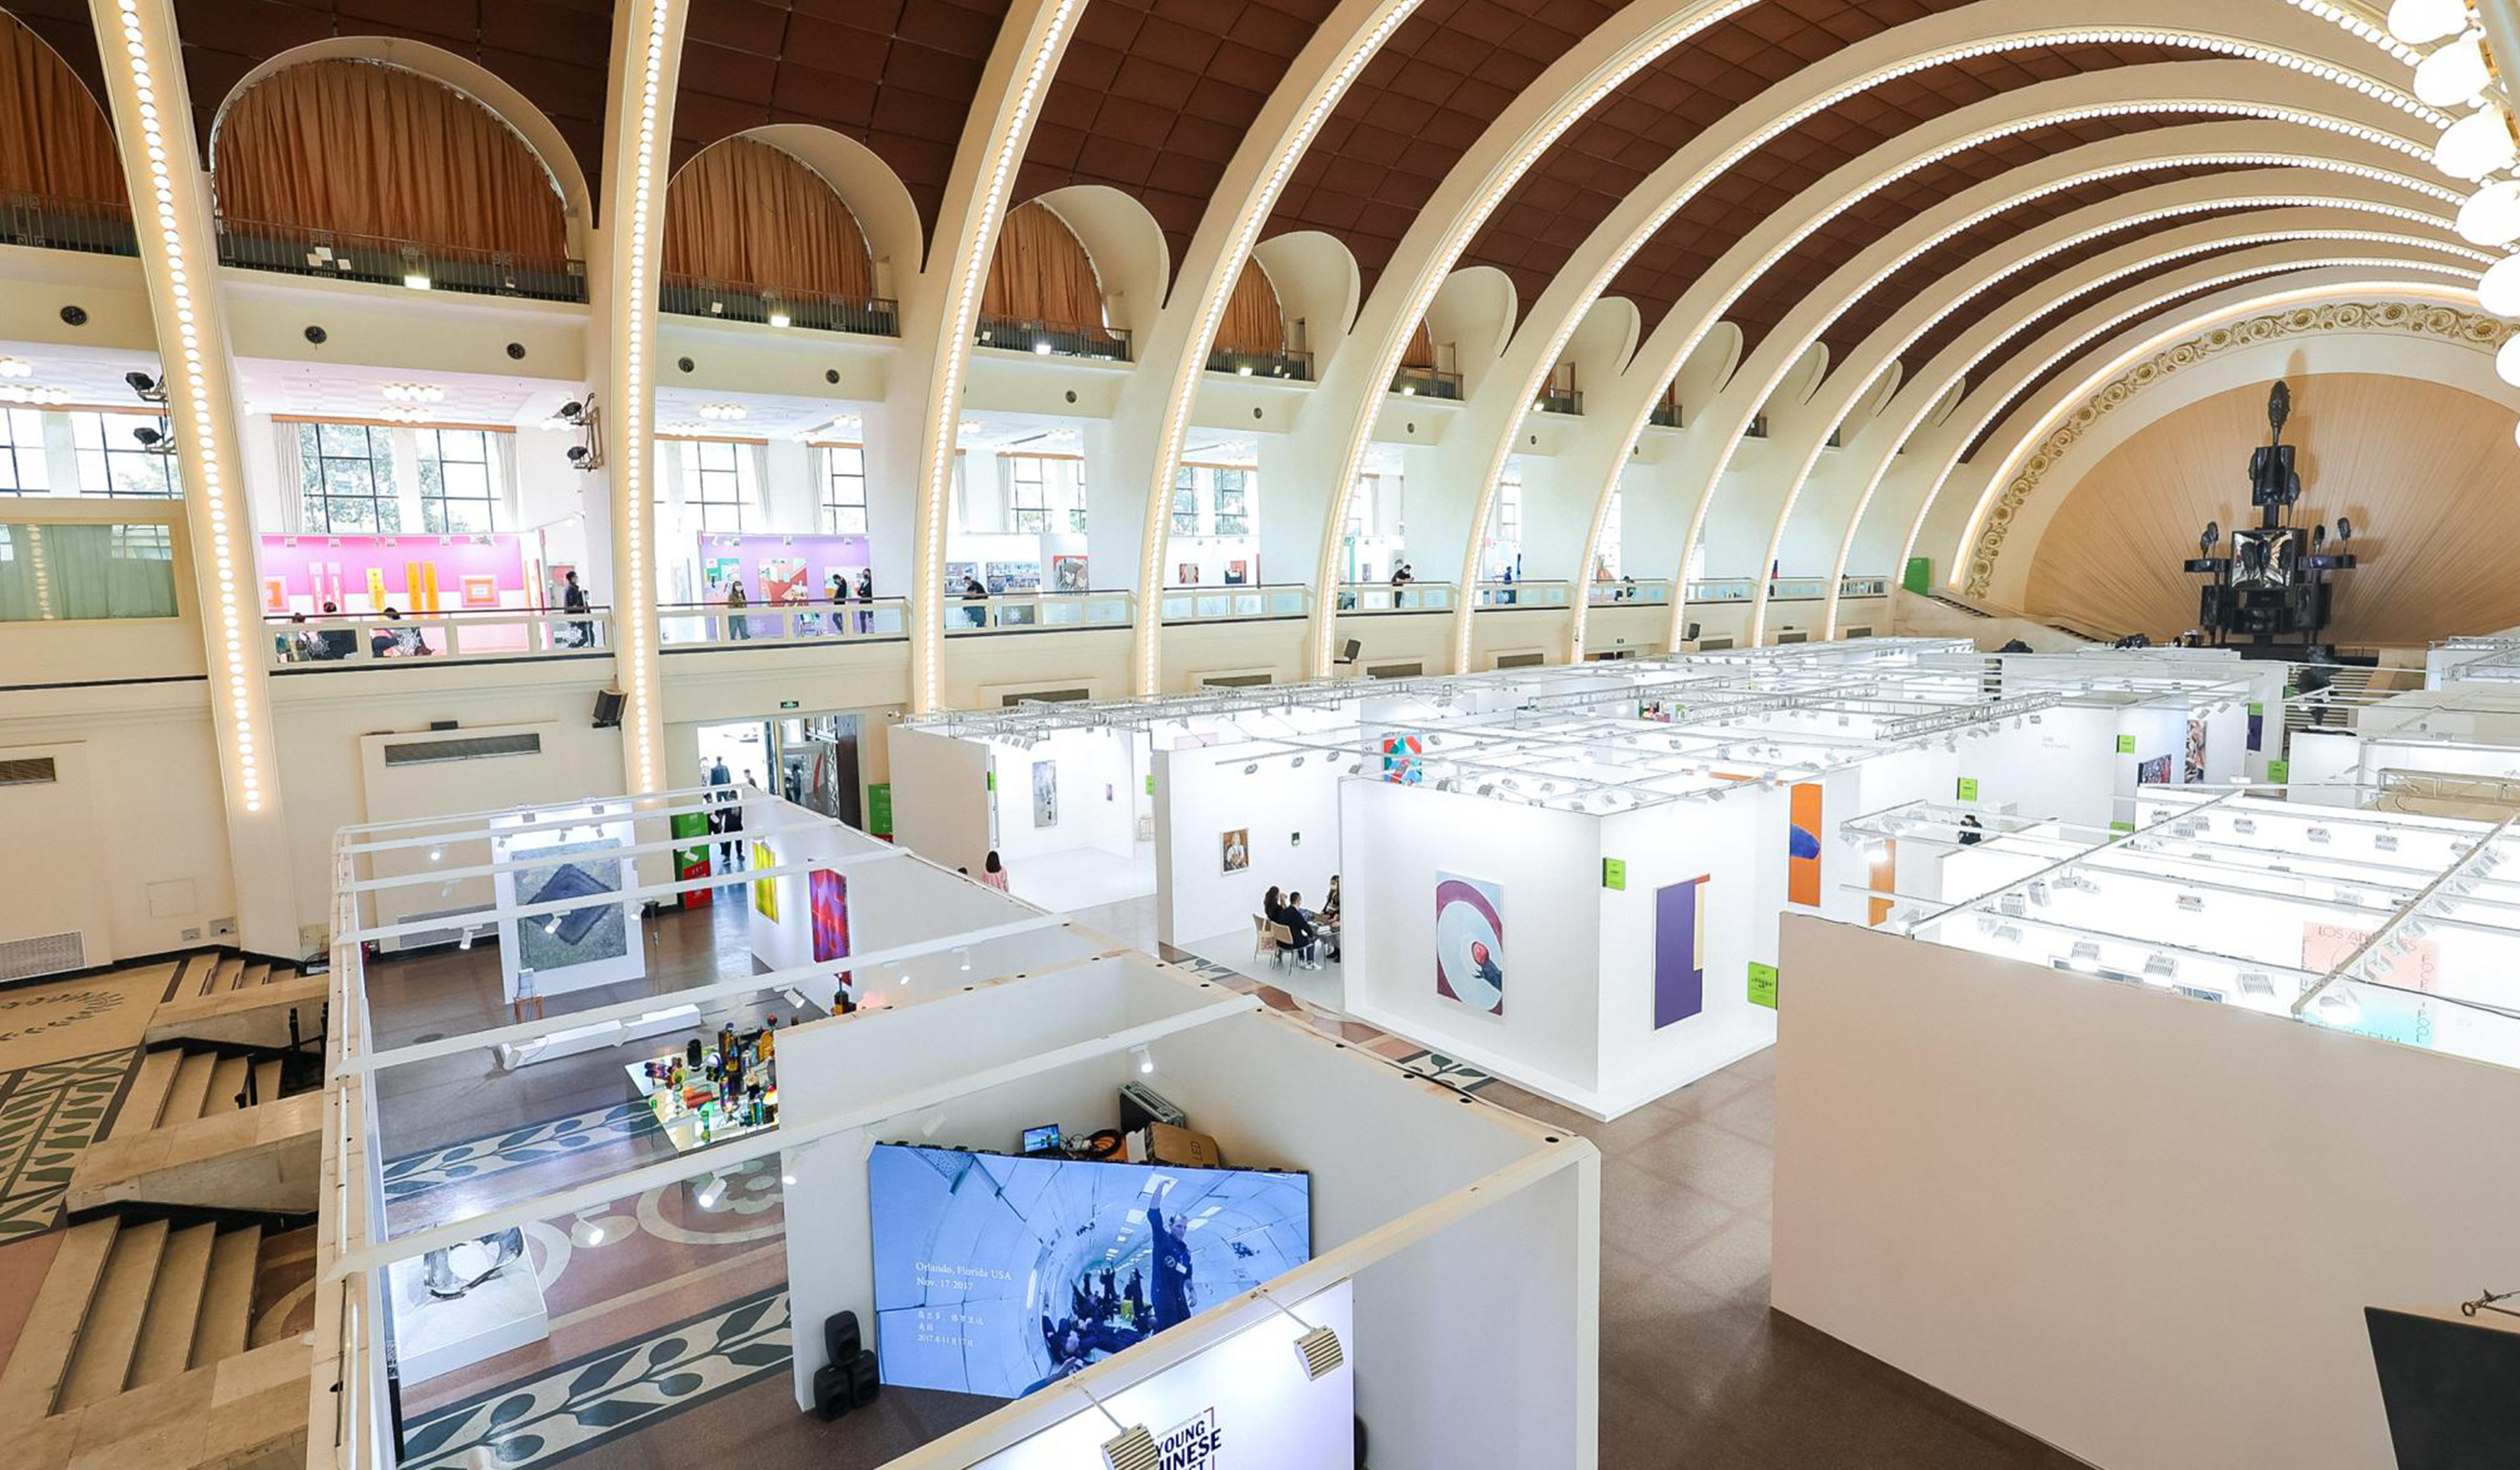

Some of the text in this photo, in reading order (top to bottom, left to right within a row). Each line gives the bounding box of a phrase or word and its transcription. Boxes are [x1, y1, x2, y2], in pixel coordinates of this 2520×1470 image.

[916, 1262, 1012, 1280] Orlando, Florida USA
[953, 1280, 974, 1290] 2017
[1156, 1420, 1205, 1458] YOUNG
